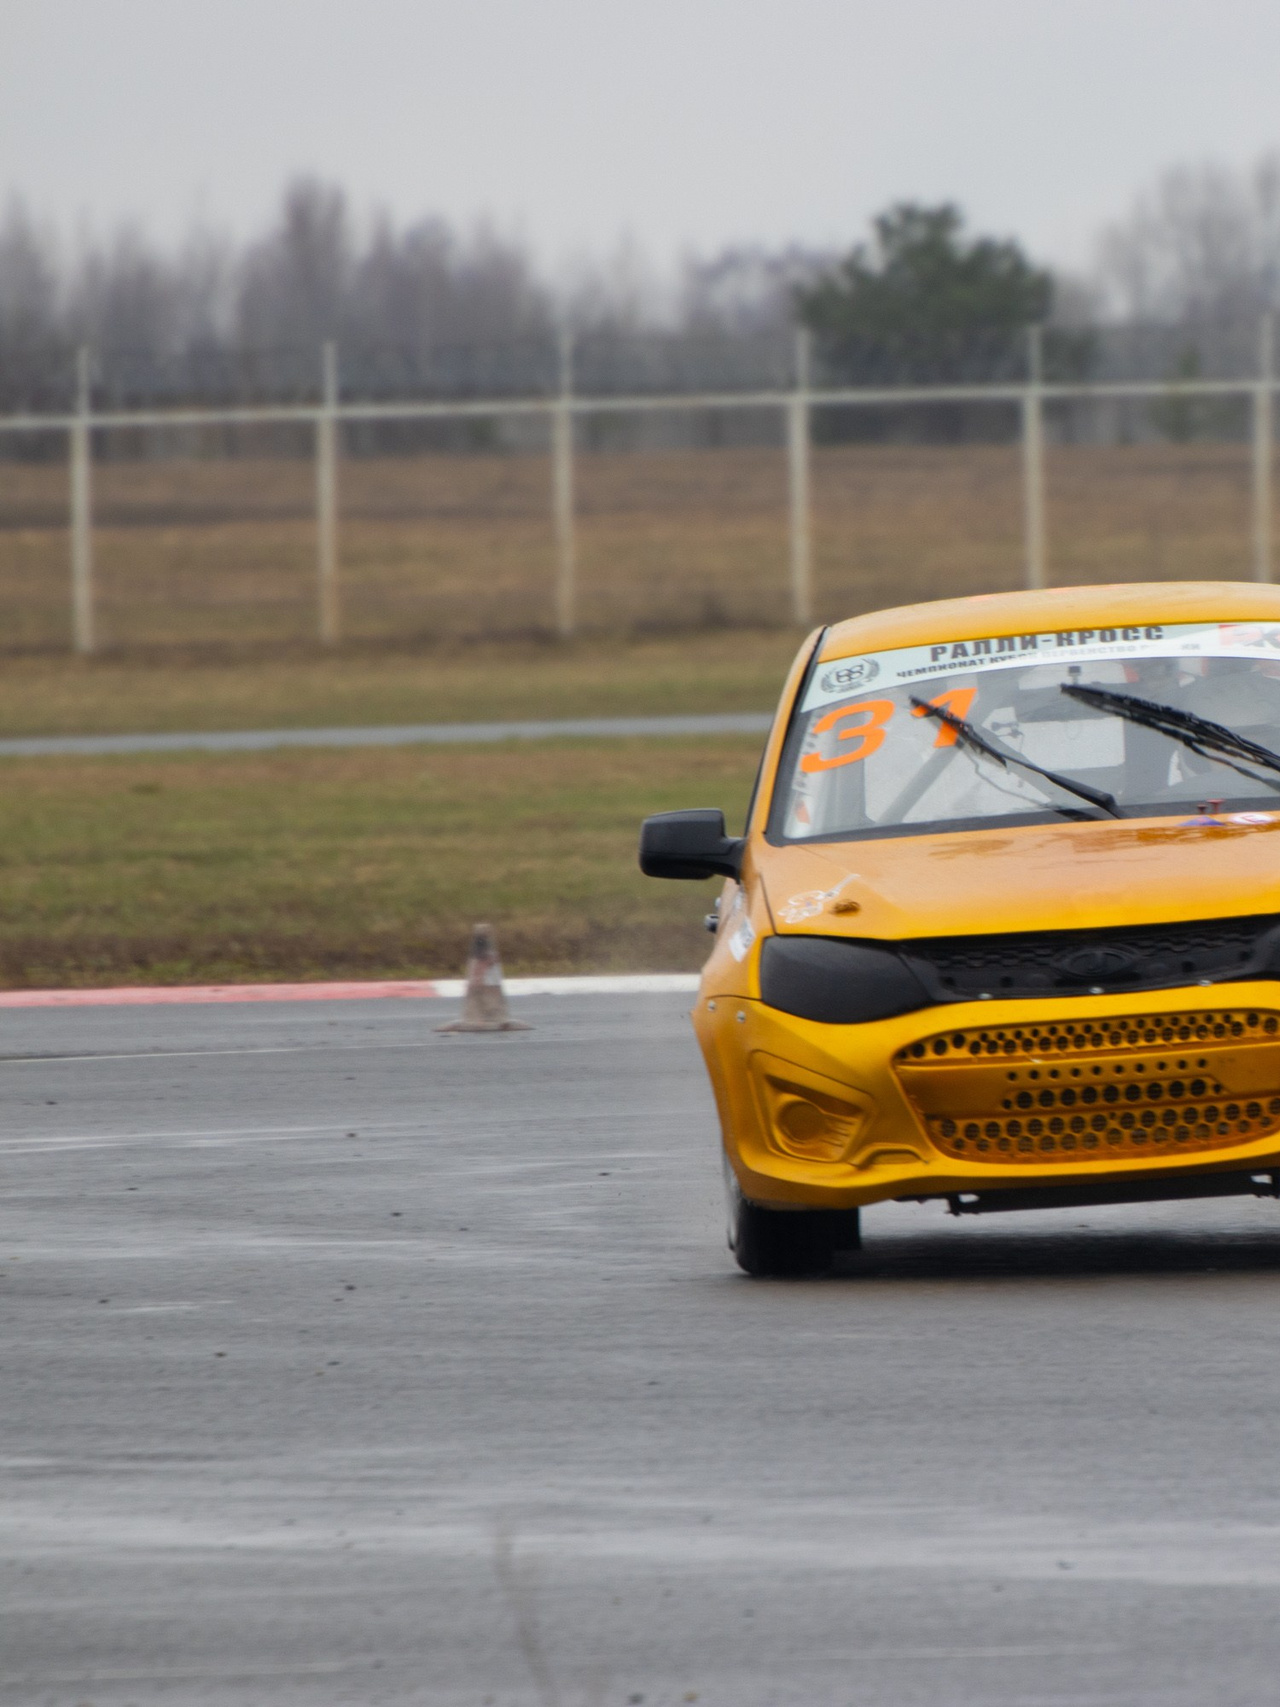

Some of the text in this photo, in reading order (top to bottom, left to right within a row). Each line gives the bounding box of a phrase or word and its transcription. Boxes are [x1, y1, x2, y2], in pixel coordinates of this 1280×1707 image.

[930, 626, 1164, 662] РАЛЛИ-КРОСС
[897, 658, 986, 677] ЧЕМПИОНАТ
[801, 687, 977, 773] 31
